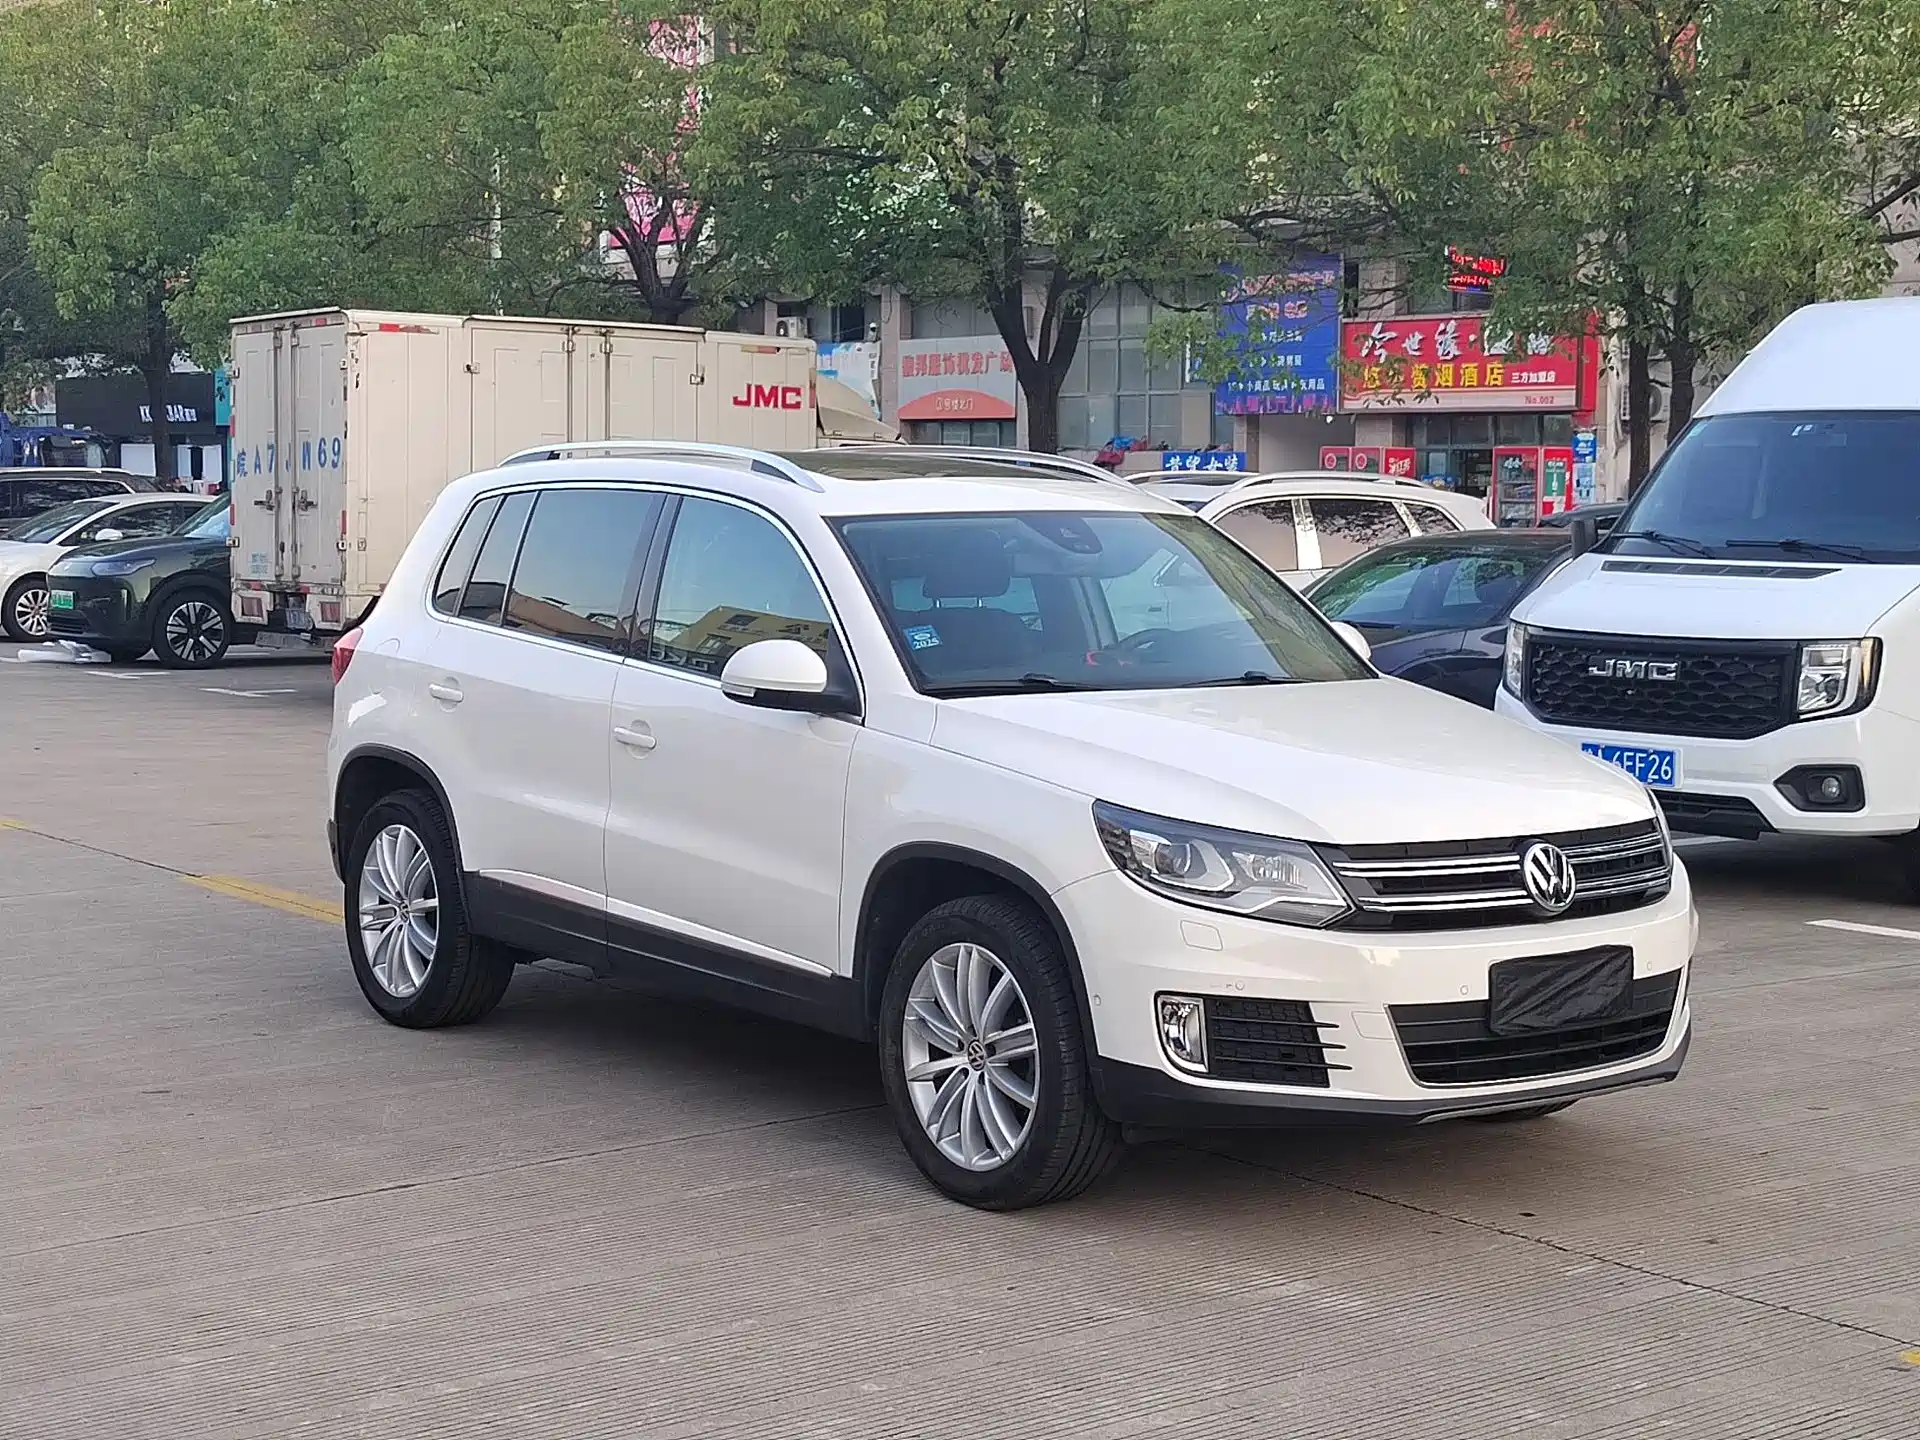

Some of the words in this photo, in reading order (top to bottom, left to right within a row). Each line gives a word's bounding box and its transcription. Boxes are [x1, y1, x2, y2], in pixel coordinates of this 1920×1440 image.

[1511, 371, 1556, 384] 三方加盟店
[732, 383, 802, 409] JMC
[913, 637, 940, 650] 2025
[1588, 659, 1678, 681] JMC
